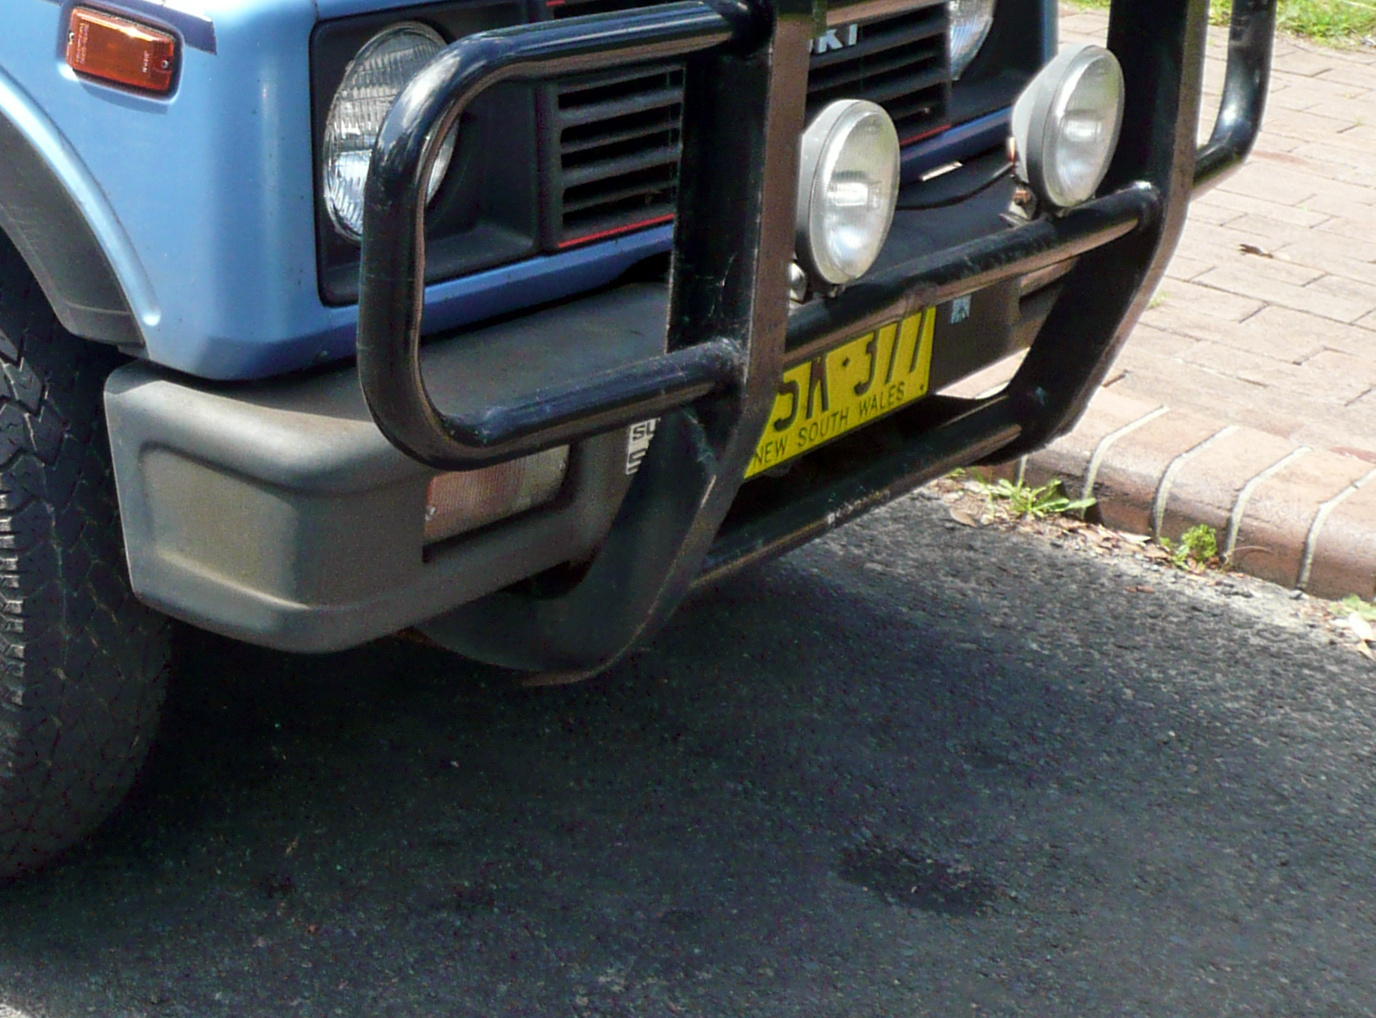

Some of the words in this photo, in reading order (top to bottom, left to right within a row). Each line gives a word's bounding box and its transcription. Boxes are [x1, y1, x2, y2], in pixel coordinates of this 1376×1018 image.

[753, 435, 788, 469] NEW
[797, 406, 850, 448] SOUTH
[858, 381, 905, 419] WALES
